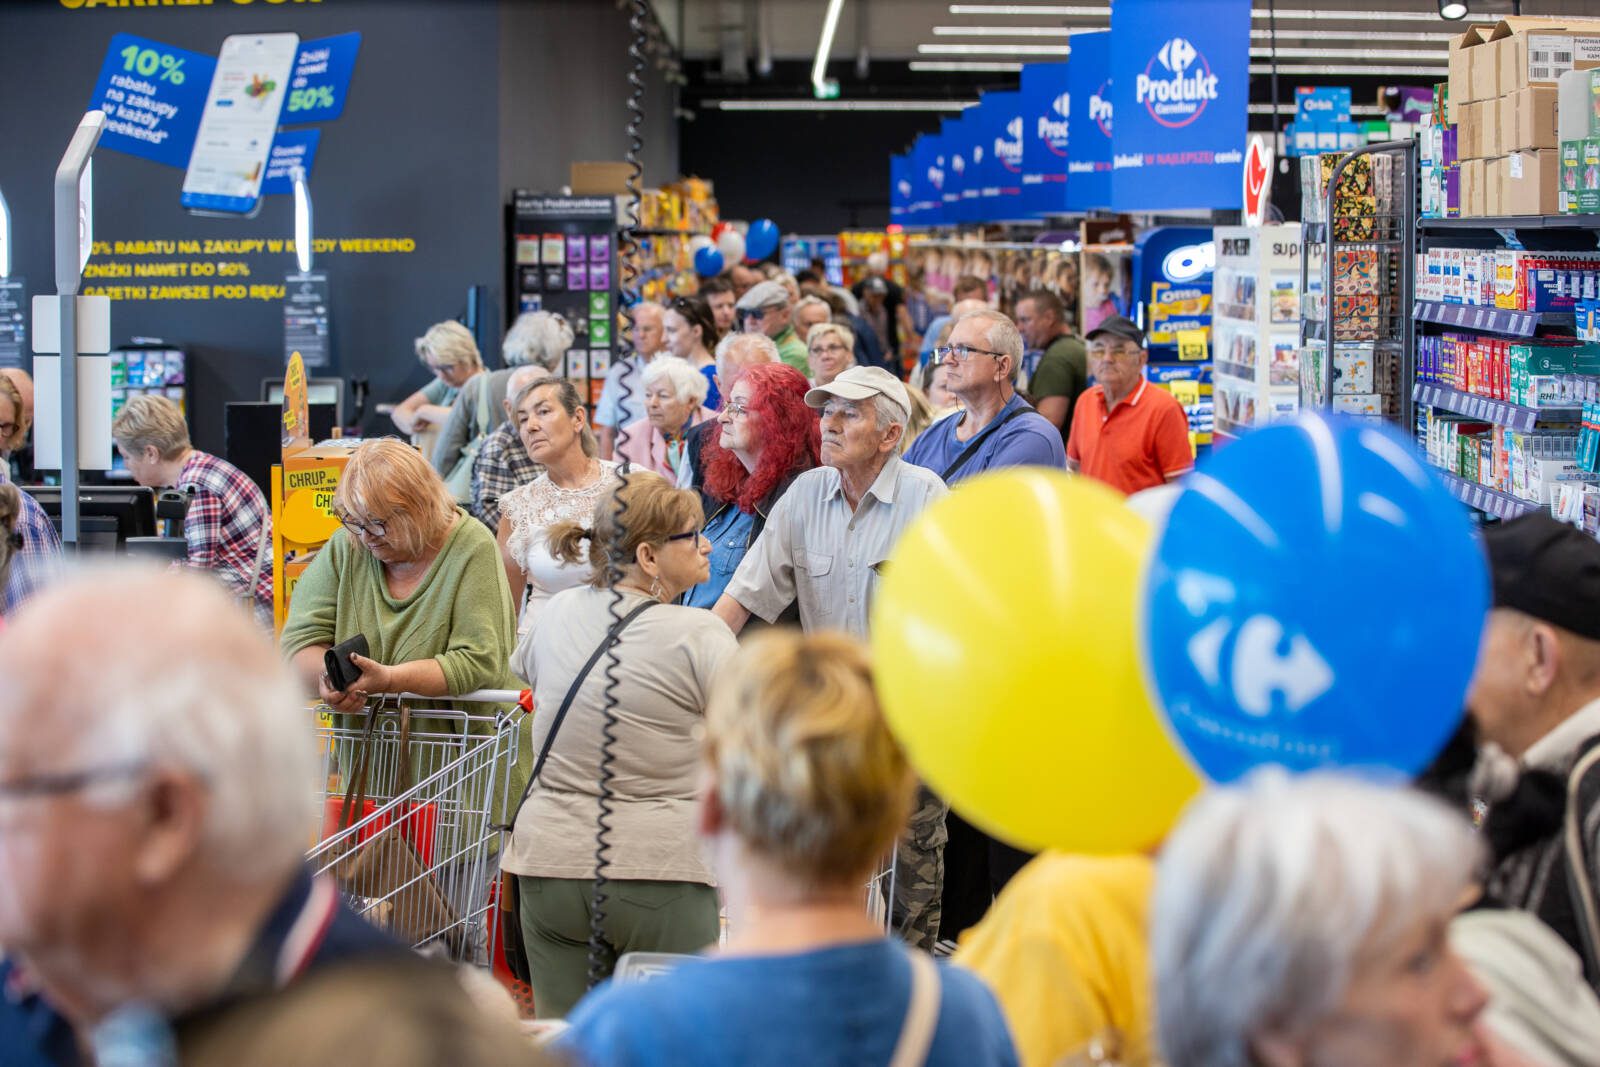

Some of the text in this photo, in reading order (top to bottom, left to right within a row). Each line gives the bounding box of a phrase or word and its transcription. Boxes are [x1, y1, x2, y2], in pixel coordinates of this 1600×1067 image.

[120, 45, 185, 85] 10%
[110, 74, 157, 96] rabatu
[1136, 68, 1218, 103] Produkt
[106, 88, 178, 119] na zakupy
[287, 85, 334, 112] 50%
[1303, 99, 1334, 111] Orbit
[101, 102, 160, 130] w każdy
[1214, 149, 1242, 165] cenie
[91, 240, 112, 255] 0%
[114, 239, 175, 254] RABATU
[178, 240, 200, 254] NA
[203, 239, 264, 254] ZAKUPY
[267, 239, 284, 252] W
[339, 238, 416, 253] WEEKEND
[84, 261, 250, 277] ZNIŻKI NAWET DO 50%
[83, 286, 147, 300] GAZETKI
[150, 286, 210, 299] ZAWSZE
[213, 286, 247, 299] POD
[289, 470, 325, 488] CHRUP
[316, 493, 334, 508] CH
